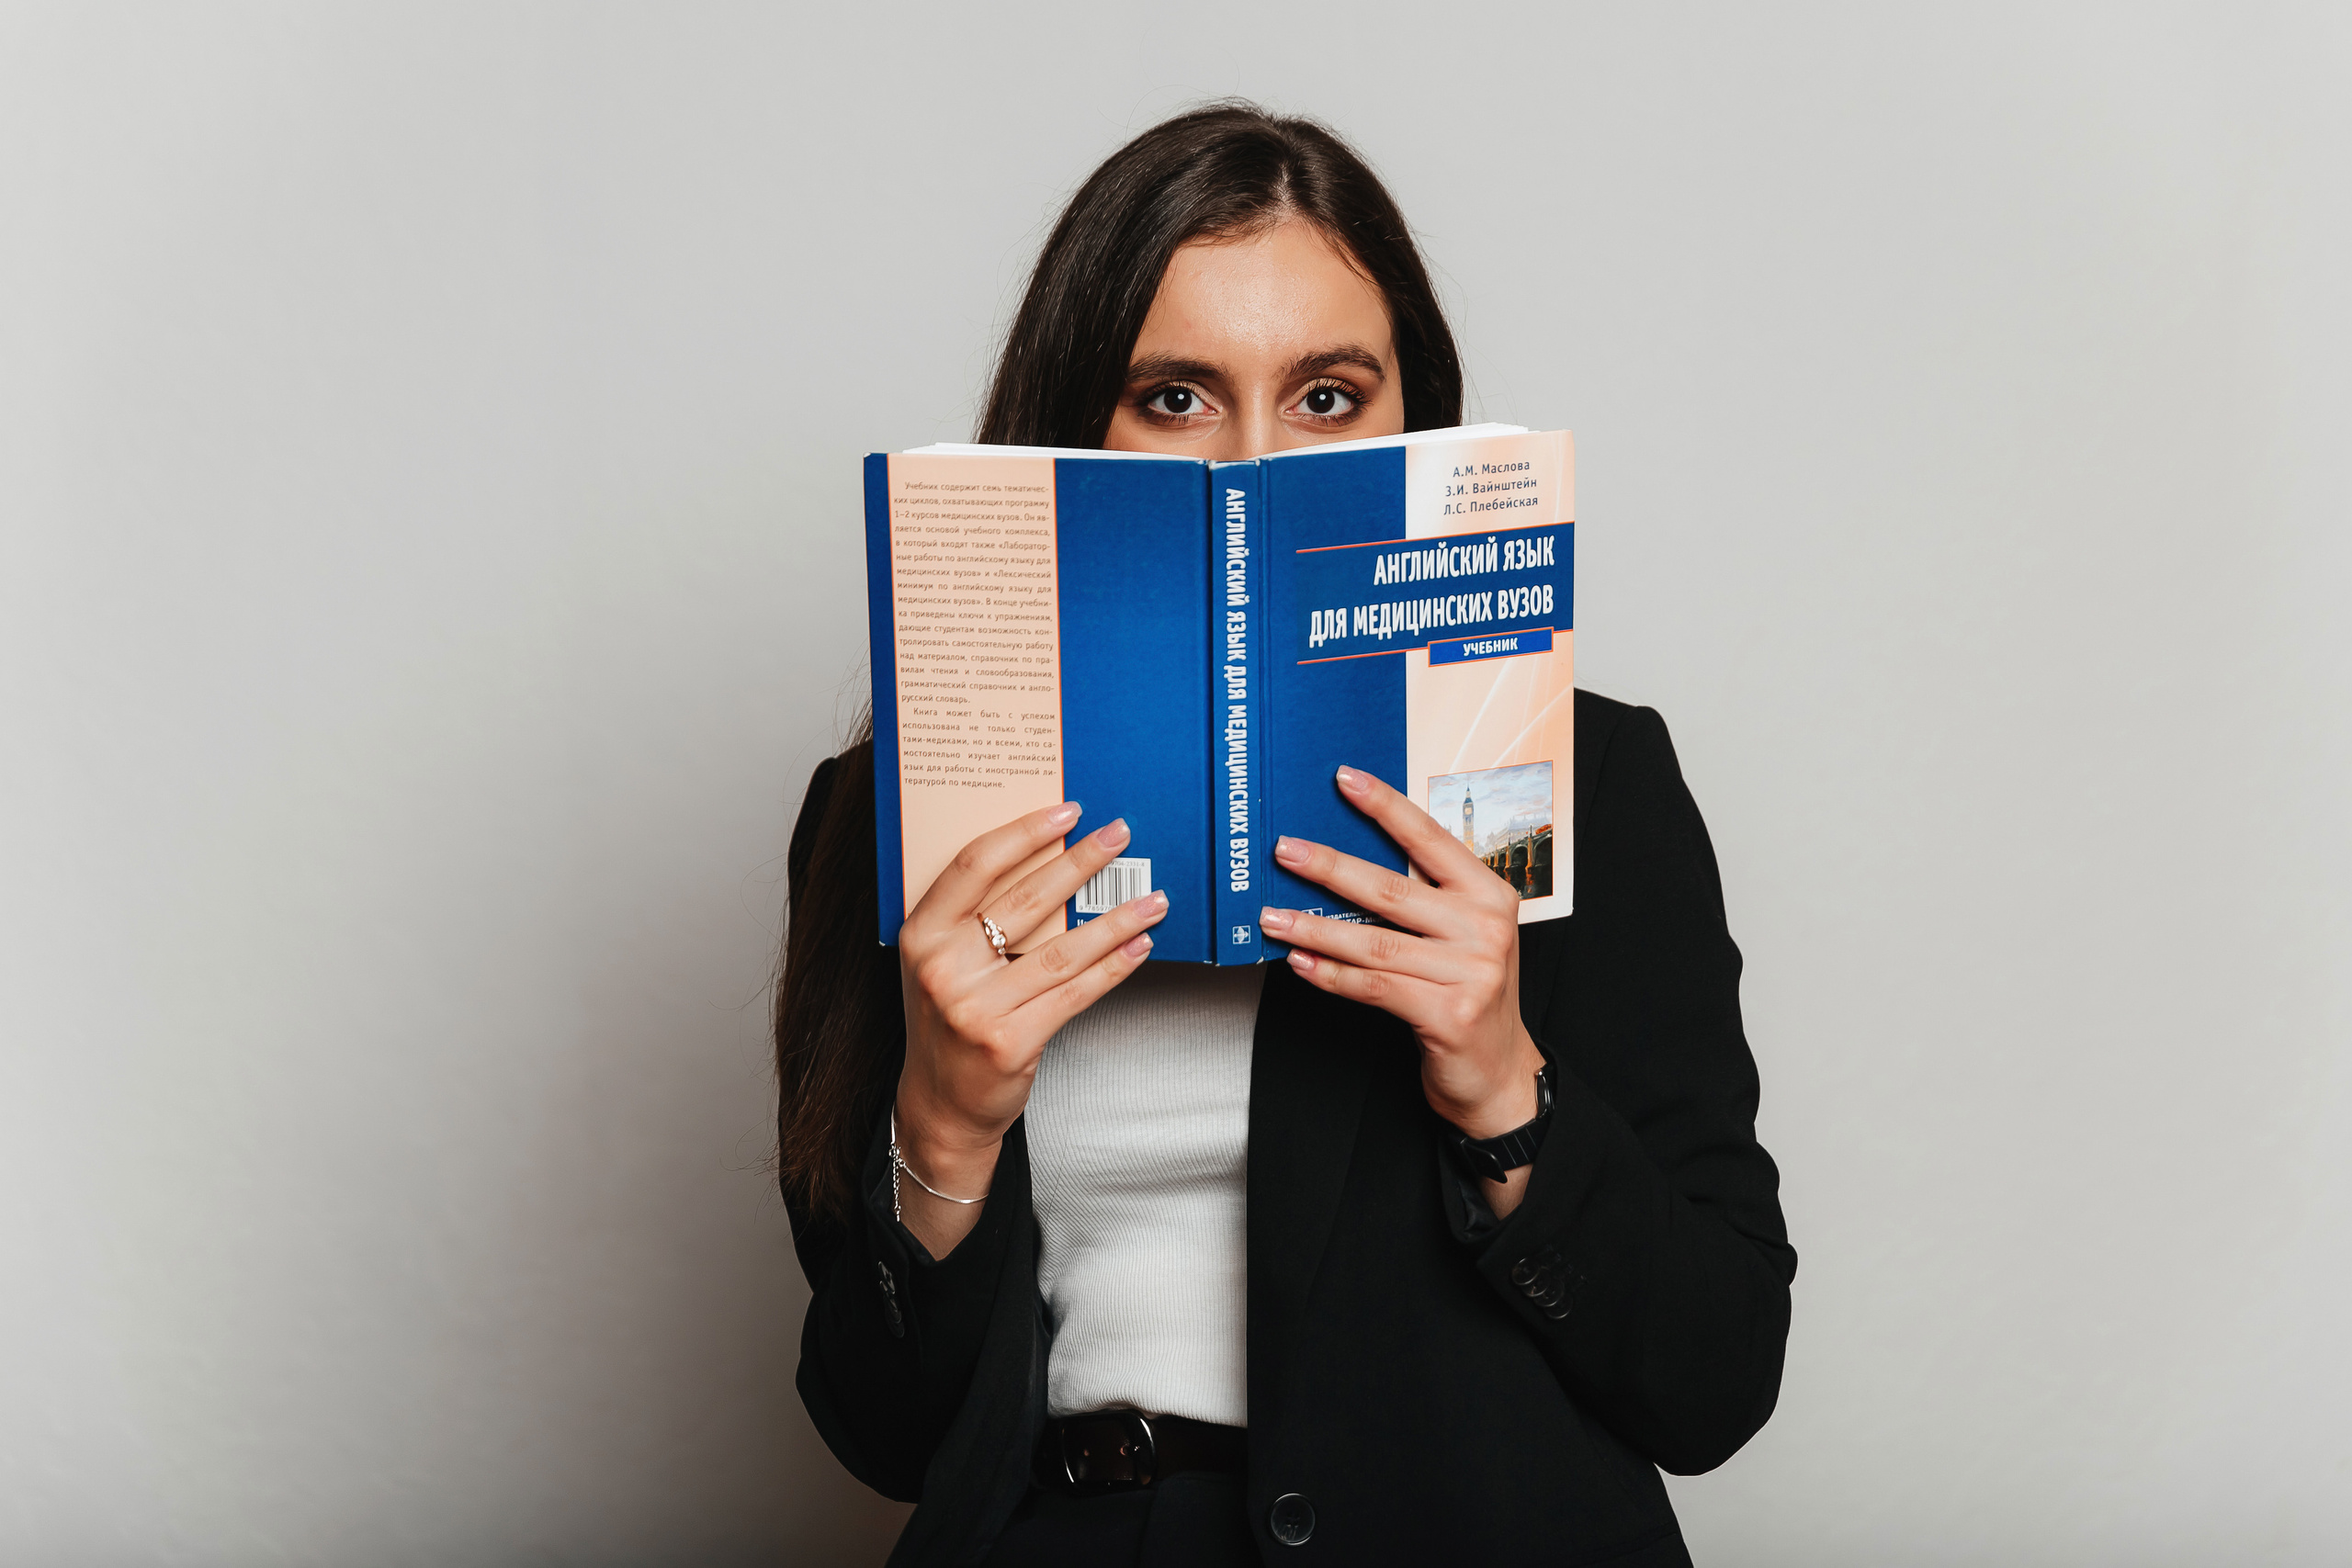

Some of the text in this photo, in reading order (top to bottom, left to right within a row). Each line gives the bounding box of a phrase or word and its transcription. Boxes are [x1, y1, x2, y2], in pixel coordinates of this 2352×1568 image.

[1453, 461, 1531, 478] А.М. Маслова
[1445, 478, 1537, 497] З.И. Вайнштейн
[1004, 501, 1050, 509] программу
[1443, 497, 1539, 515] Л.С. Плебейская
[998, 541, 1051, 551] «Лаборатор-
[913, 553, 943, 562] работы
[956, 556, 1009, 565] английскому
[1010, 558, 1035, 566] языку
[1374, 535, 1555, 586] АНГЛИЙСКИЙ ЯЗЫК
[992, 570, 1052, 578] «Лексический
[952, 583, 1005, 593] английскому
[1019, 599, 1053, 608] учебни-
[1309, 584, 1555, 649] ДЛЯ МЕДИЦИНСКИХ ВУЗОВ
[1025, 641, 1054, 651] работу
[1463, 637, 1519, 657] УЧЕБНИК
[1224, 488, 1250, 893] АНГЛИЙСКИЙ ЯЗЫК ДЛЯ МЕДИЦИНСКИХ ВУЗОВ
[901, 694, 933, 703] русский
[944, 764, 975, 773] работы
[904, 778, 946, 786] тературой
